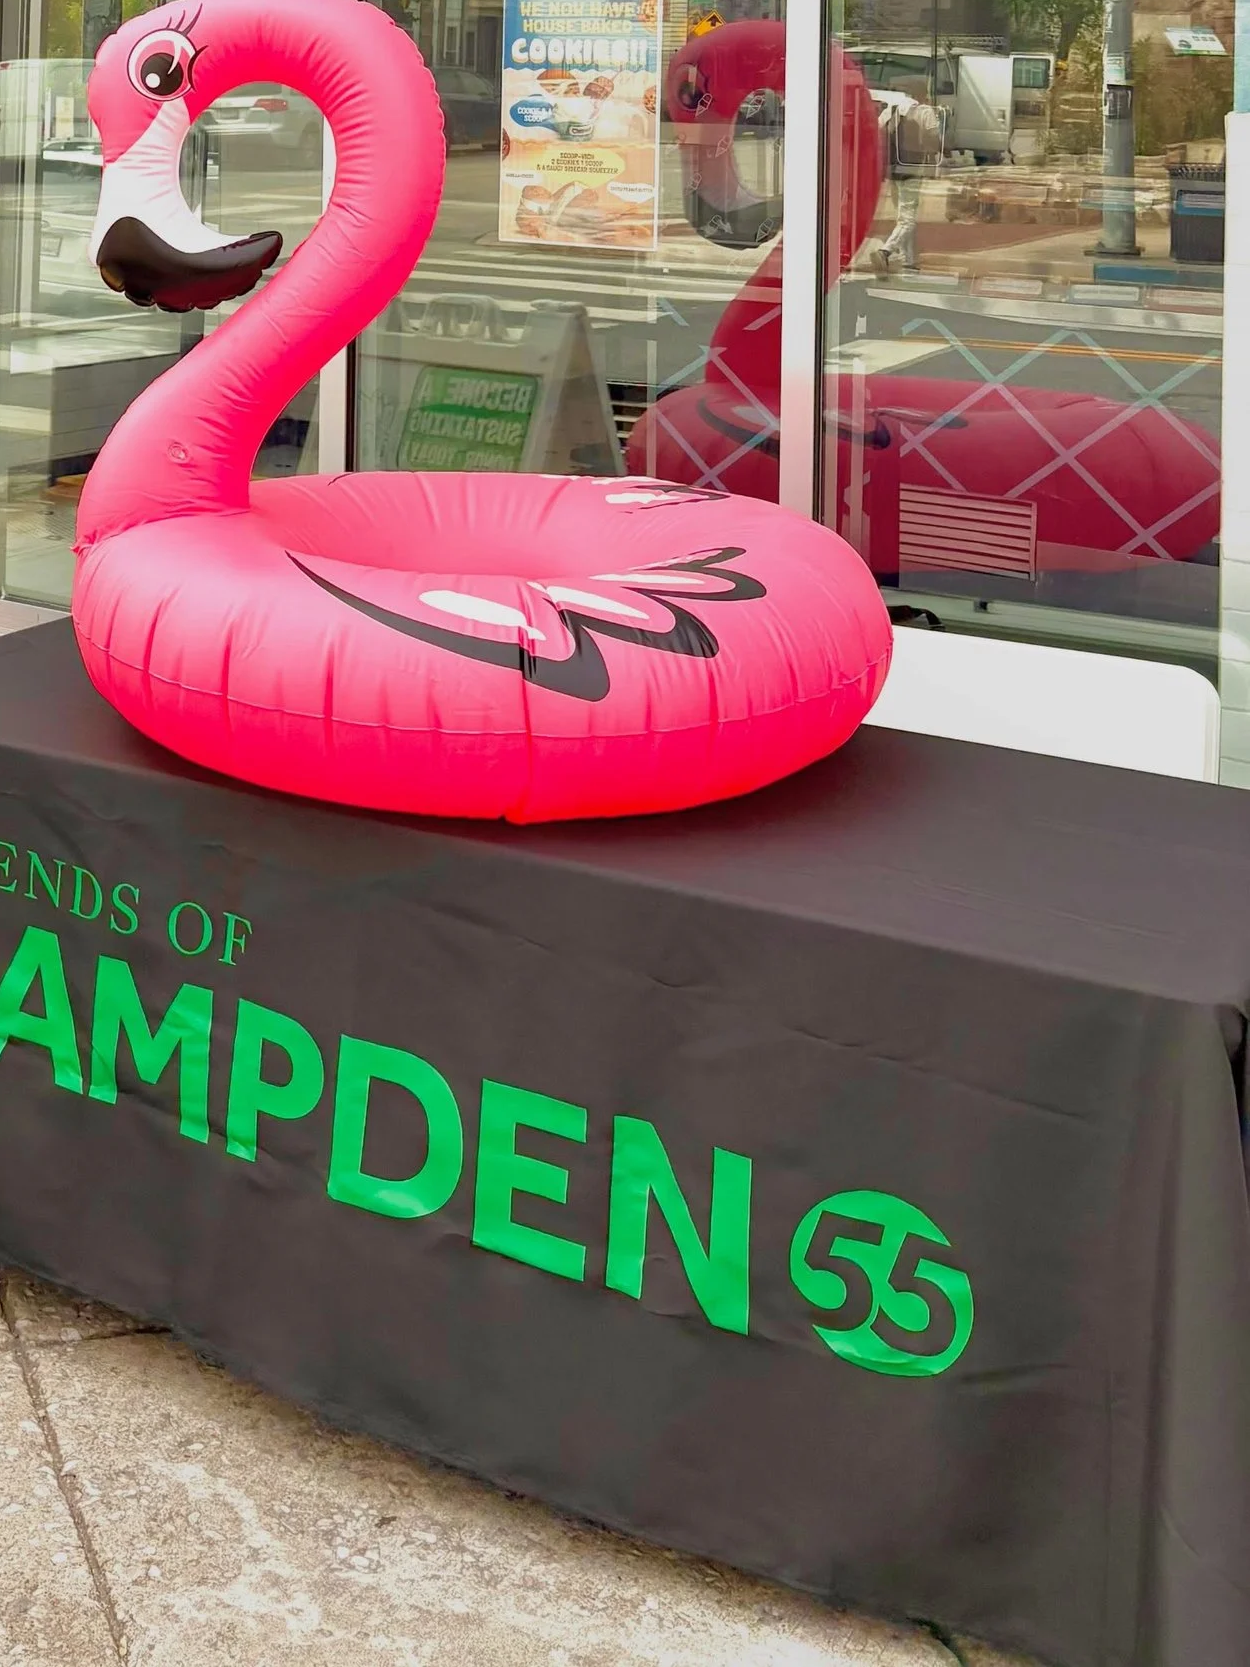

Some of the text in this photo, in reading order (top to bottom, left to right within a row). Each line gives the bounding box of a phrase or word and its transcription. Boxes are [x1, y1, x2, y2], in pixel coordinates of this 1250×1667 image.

[520, 1, 637, 16] WE NOW HAVE
[523, 19, 632, 33] HOUSE BAKED
[511, 37, 648, 67] COOKIES!!
[164, 900, 254, 967] OF
[789, 1191, 974, 1376] 55
